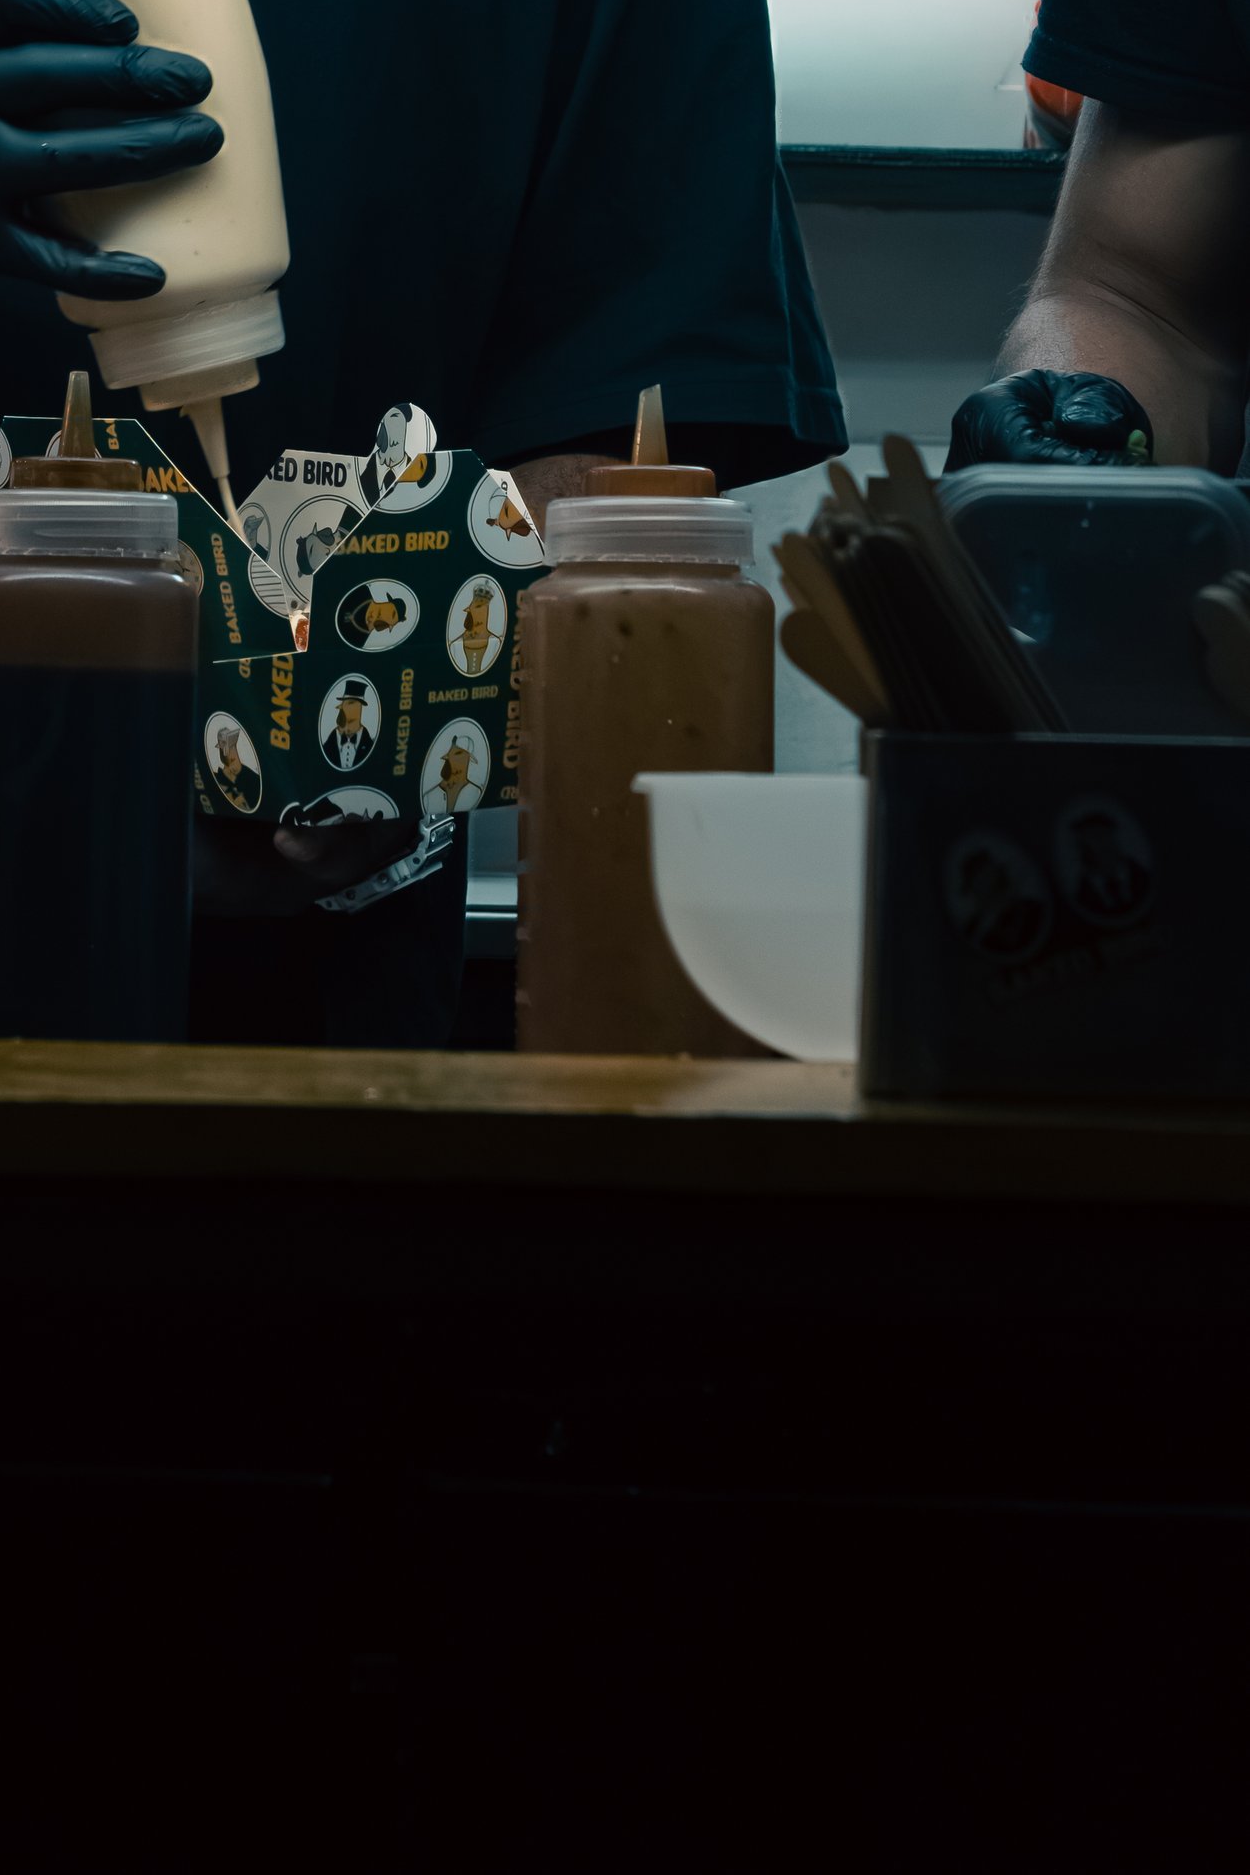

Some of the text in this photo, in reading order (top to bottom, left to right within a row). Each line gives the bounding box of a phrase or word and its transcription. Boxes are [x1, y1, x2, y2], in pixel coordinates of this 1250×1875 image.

[303, 459, 347, 488] BIRD
[404, 529, 450, 552] BIRD
[209, 532, 243, 645] BAKED BIRD
[270, 654, 295, 751] BAKED
[393, 667, 415, 777] BAKED BIRD
[427, 684, 499, 704] BAKED BIRD
